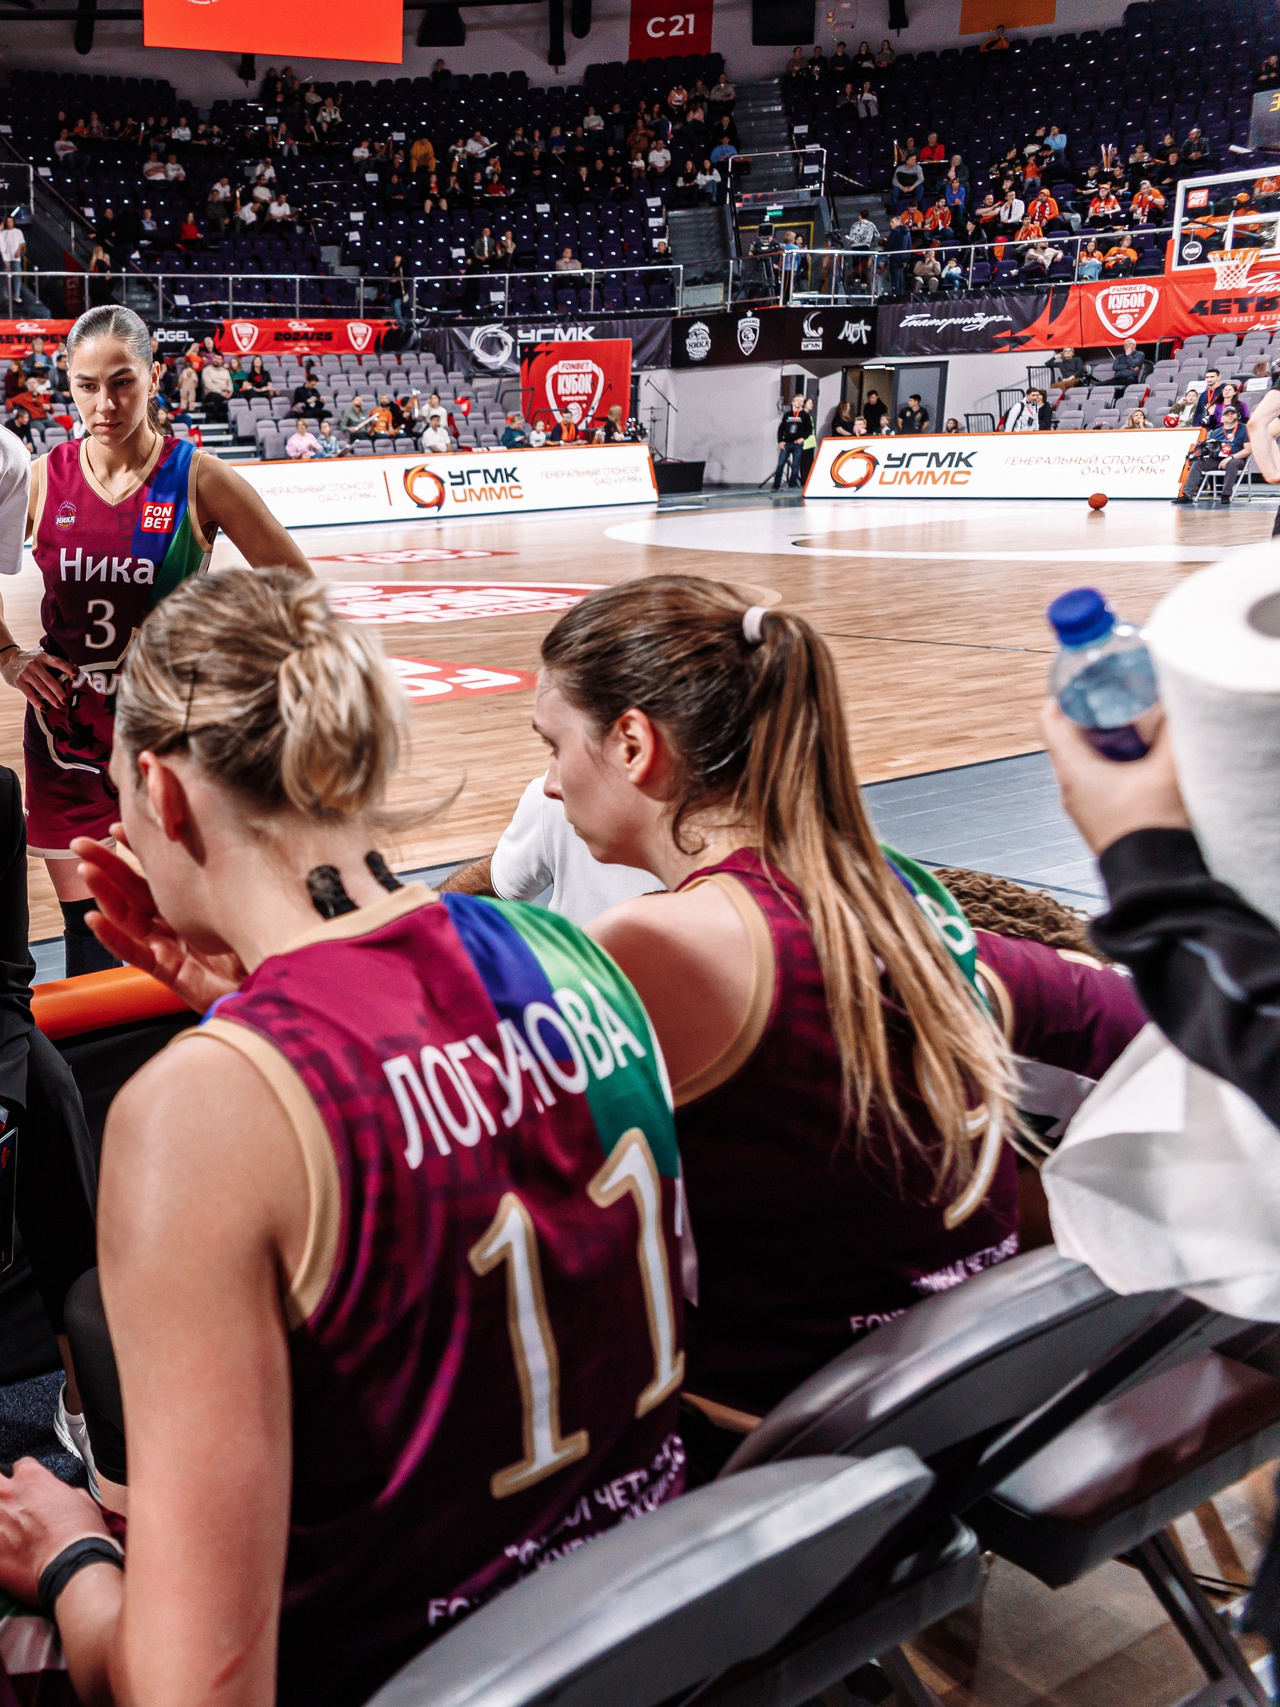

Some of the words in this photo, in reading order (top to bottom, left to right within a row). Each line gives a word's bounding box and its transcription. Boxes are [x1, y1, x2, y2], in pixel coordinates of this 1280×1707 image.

[1108, 293, 1145, 309] КУБОК
[1222, 316, 1255, 324] FONBET
[273, 332, 333, 342] 2024/25
[558, 374, 593, 395] КУБОК
[884, 452, 978, 468] УГМК
[1005, 454, 1099, 466] ГЕНЕРАЛЬНЫЙ
[1102, 454, 1170, 465] СПОНСОР
[448, 467, 520, 486] УГМК
[541, 469, 601, 480] ГЕНЕРАЛЬНЫЙ
[603, 466, 641, 476] СПОНСОР
[878, 470, 971, 485] UMMC
[1081, 466, 1111, 476] ОАО
[1115, 466, 1165, 475] «УГМК»
[329, 481, 376, 492] СПОНСОР
[452, 485, 524, 503] UMMC
[144, 505, 173, 517] FON
[143, 517, 172, 529] BET
[60, 547, 154, 585] Ника
[85, 599, 117, 650] 3
[469, 1128, 685, 1500] 11
